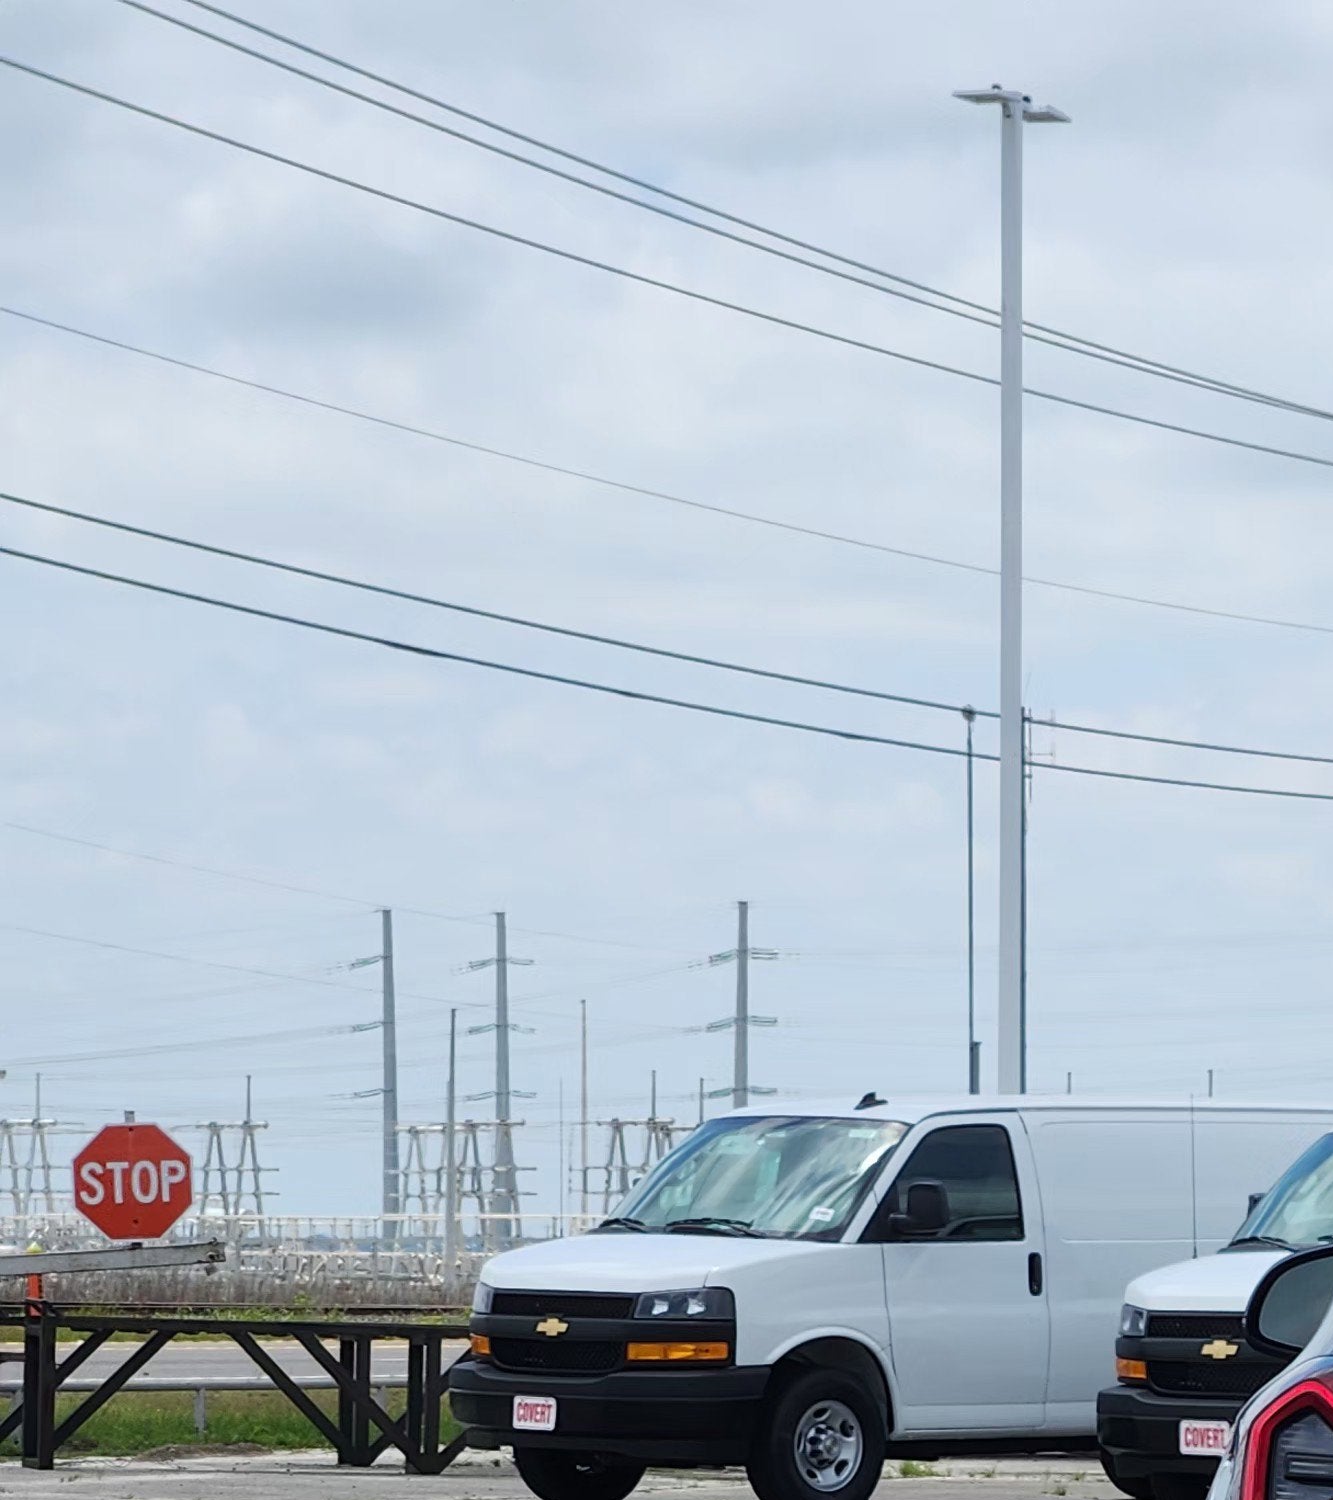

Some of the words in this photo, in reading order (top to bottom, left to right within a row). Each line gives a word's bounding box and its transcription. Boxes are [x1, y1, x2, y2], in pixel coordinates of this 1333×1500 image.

[79, 1159, 187, 1206] STOP
[517, 1402, 553, 1424] COVERT
[1184, 1427, 1227, 1449] COVERT
